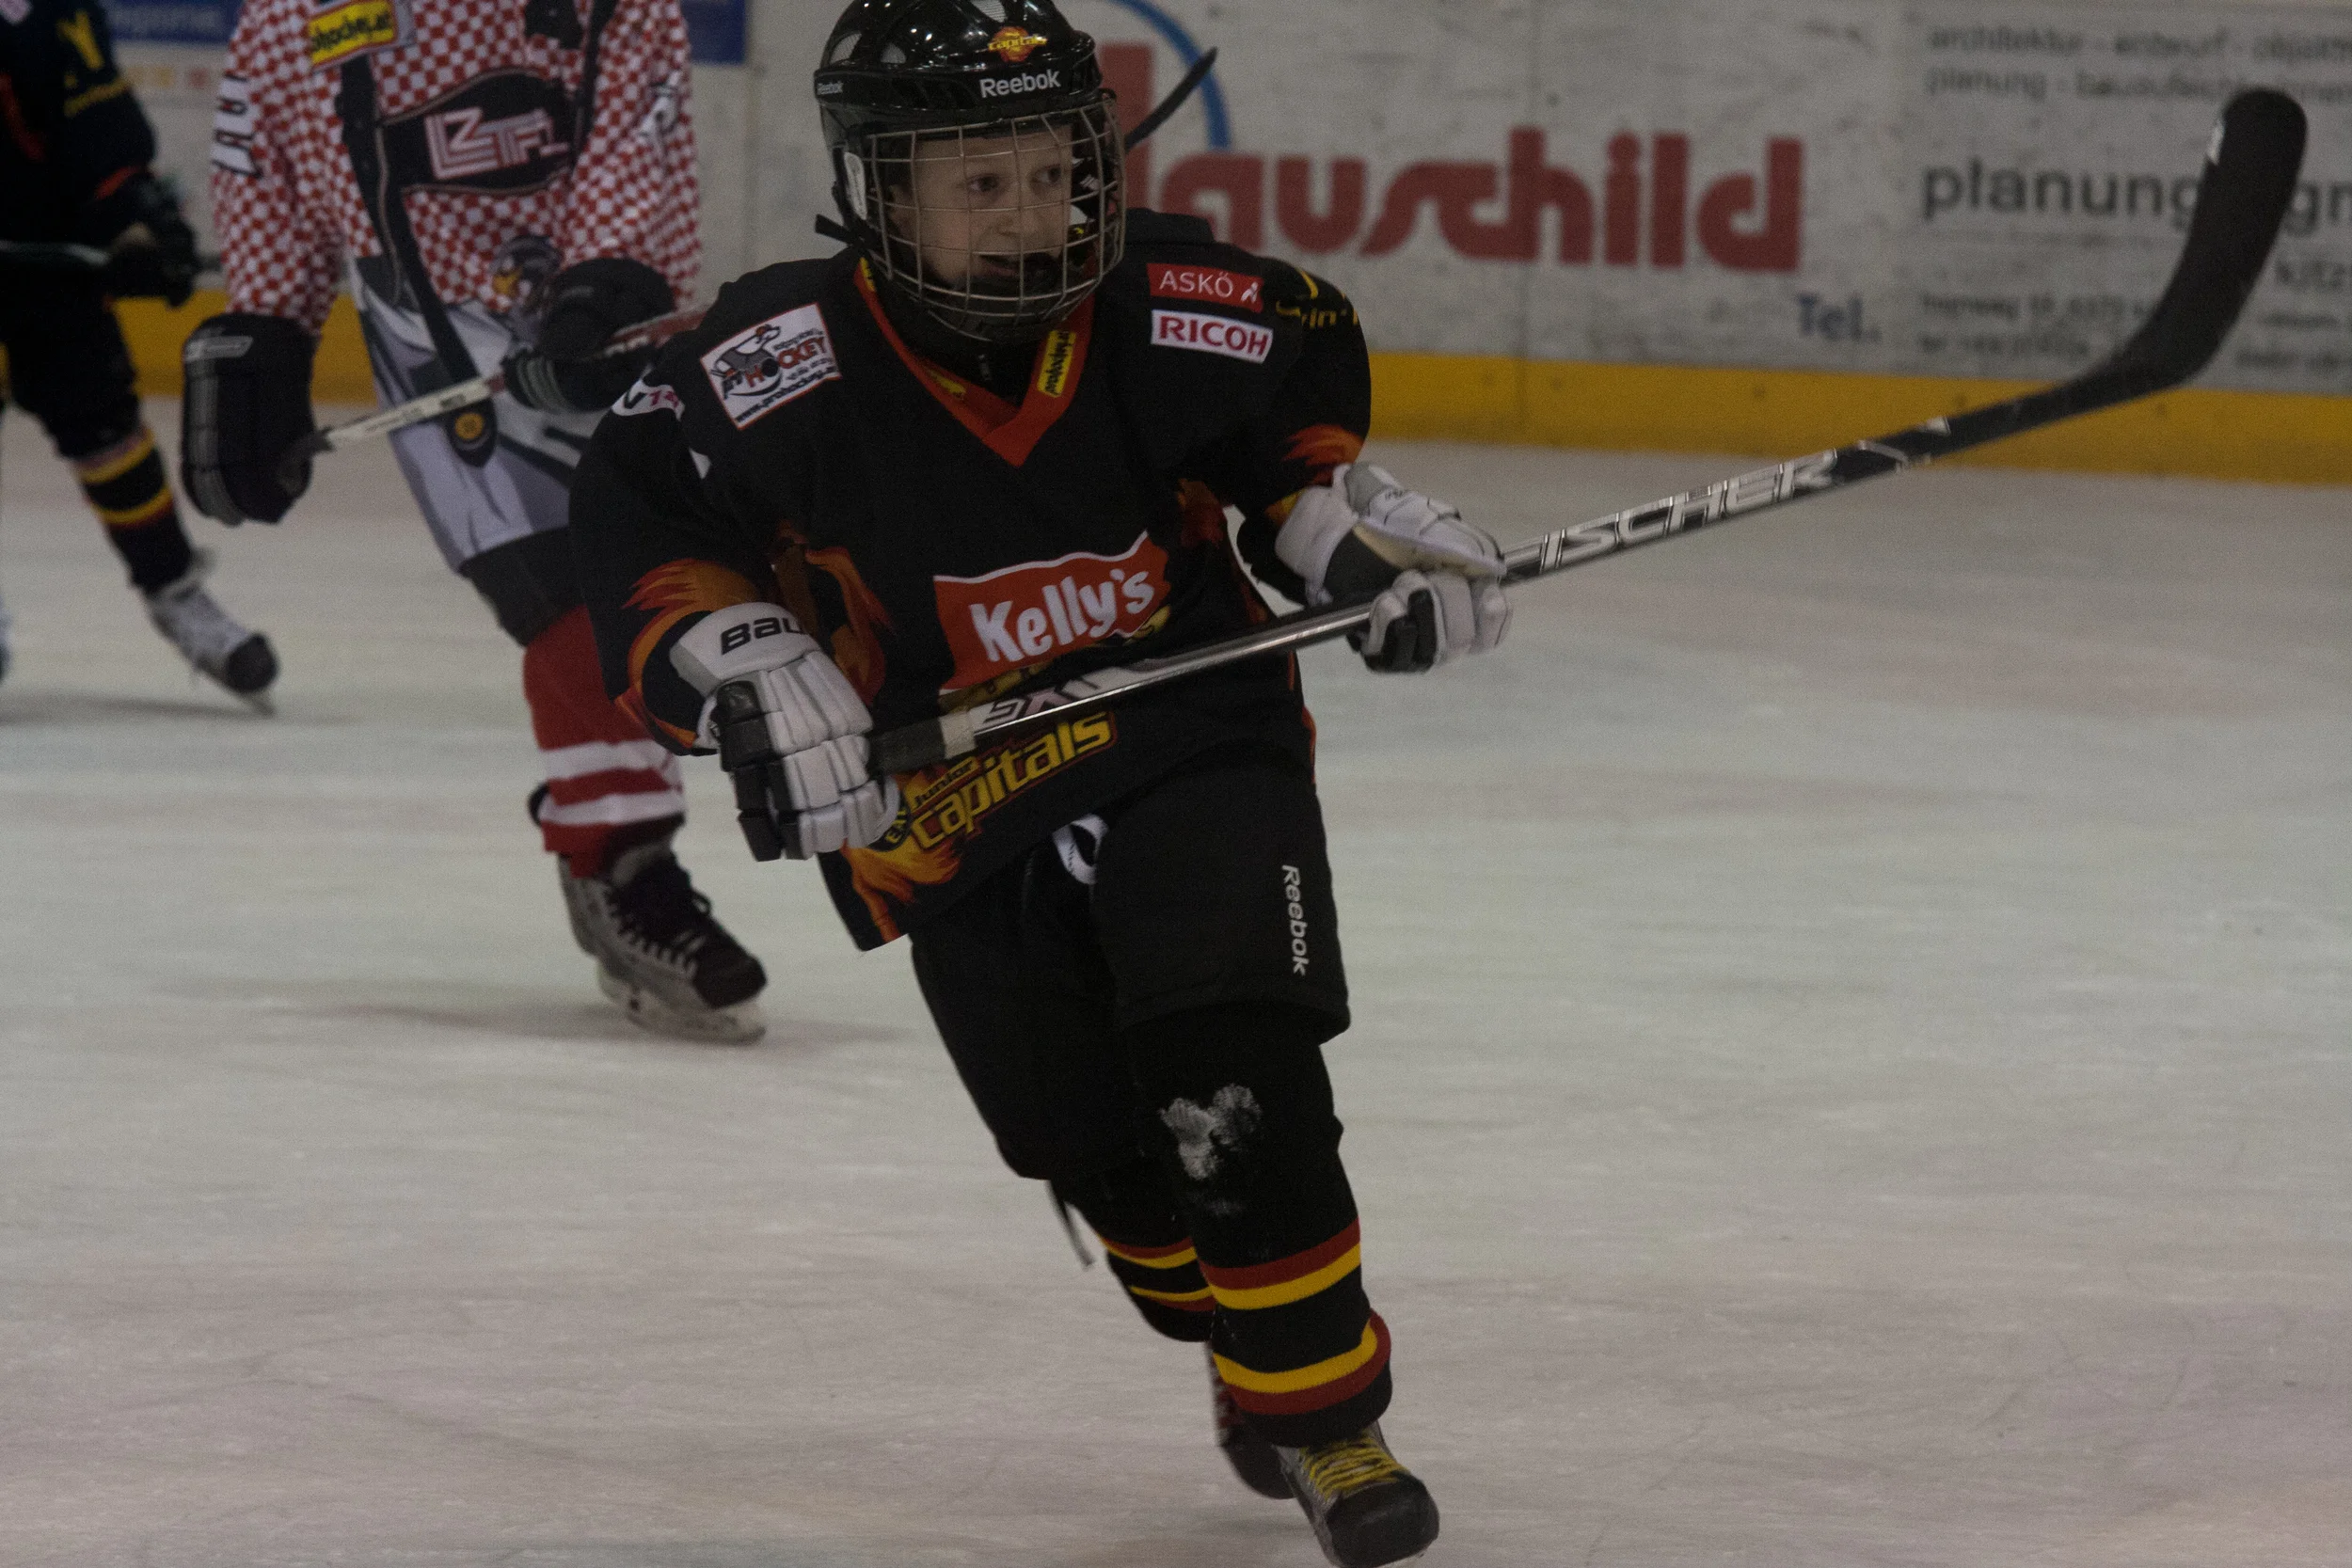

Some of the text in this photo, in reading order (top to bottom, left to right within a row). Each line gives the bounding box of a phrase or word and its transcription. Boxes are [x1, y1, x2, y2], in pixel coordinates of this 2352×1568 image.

[979, 69, 1061, 98] Reebok
[1158, 269, 1234, 299] ASKÖ
[1158, 315, 1269, 357] RICOH
[968, 567, 1155, 663] Kelly's
[1281, 864, 1310, 976] Reebok
